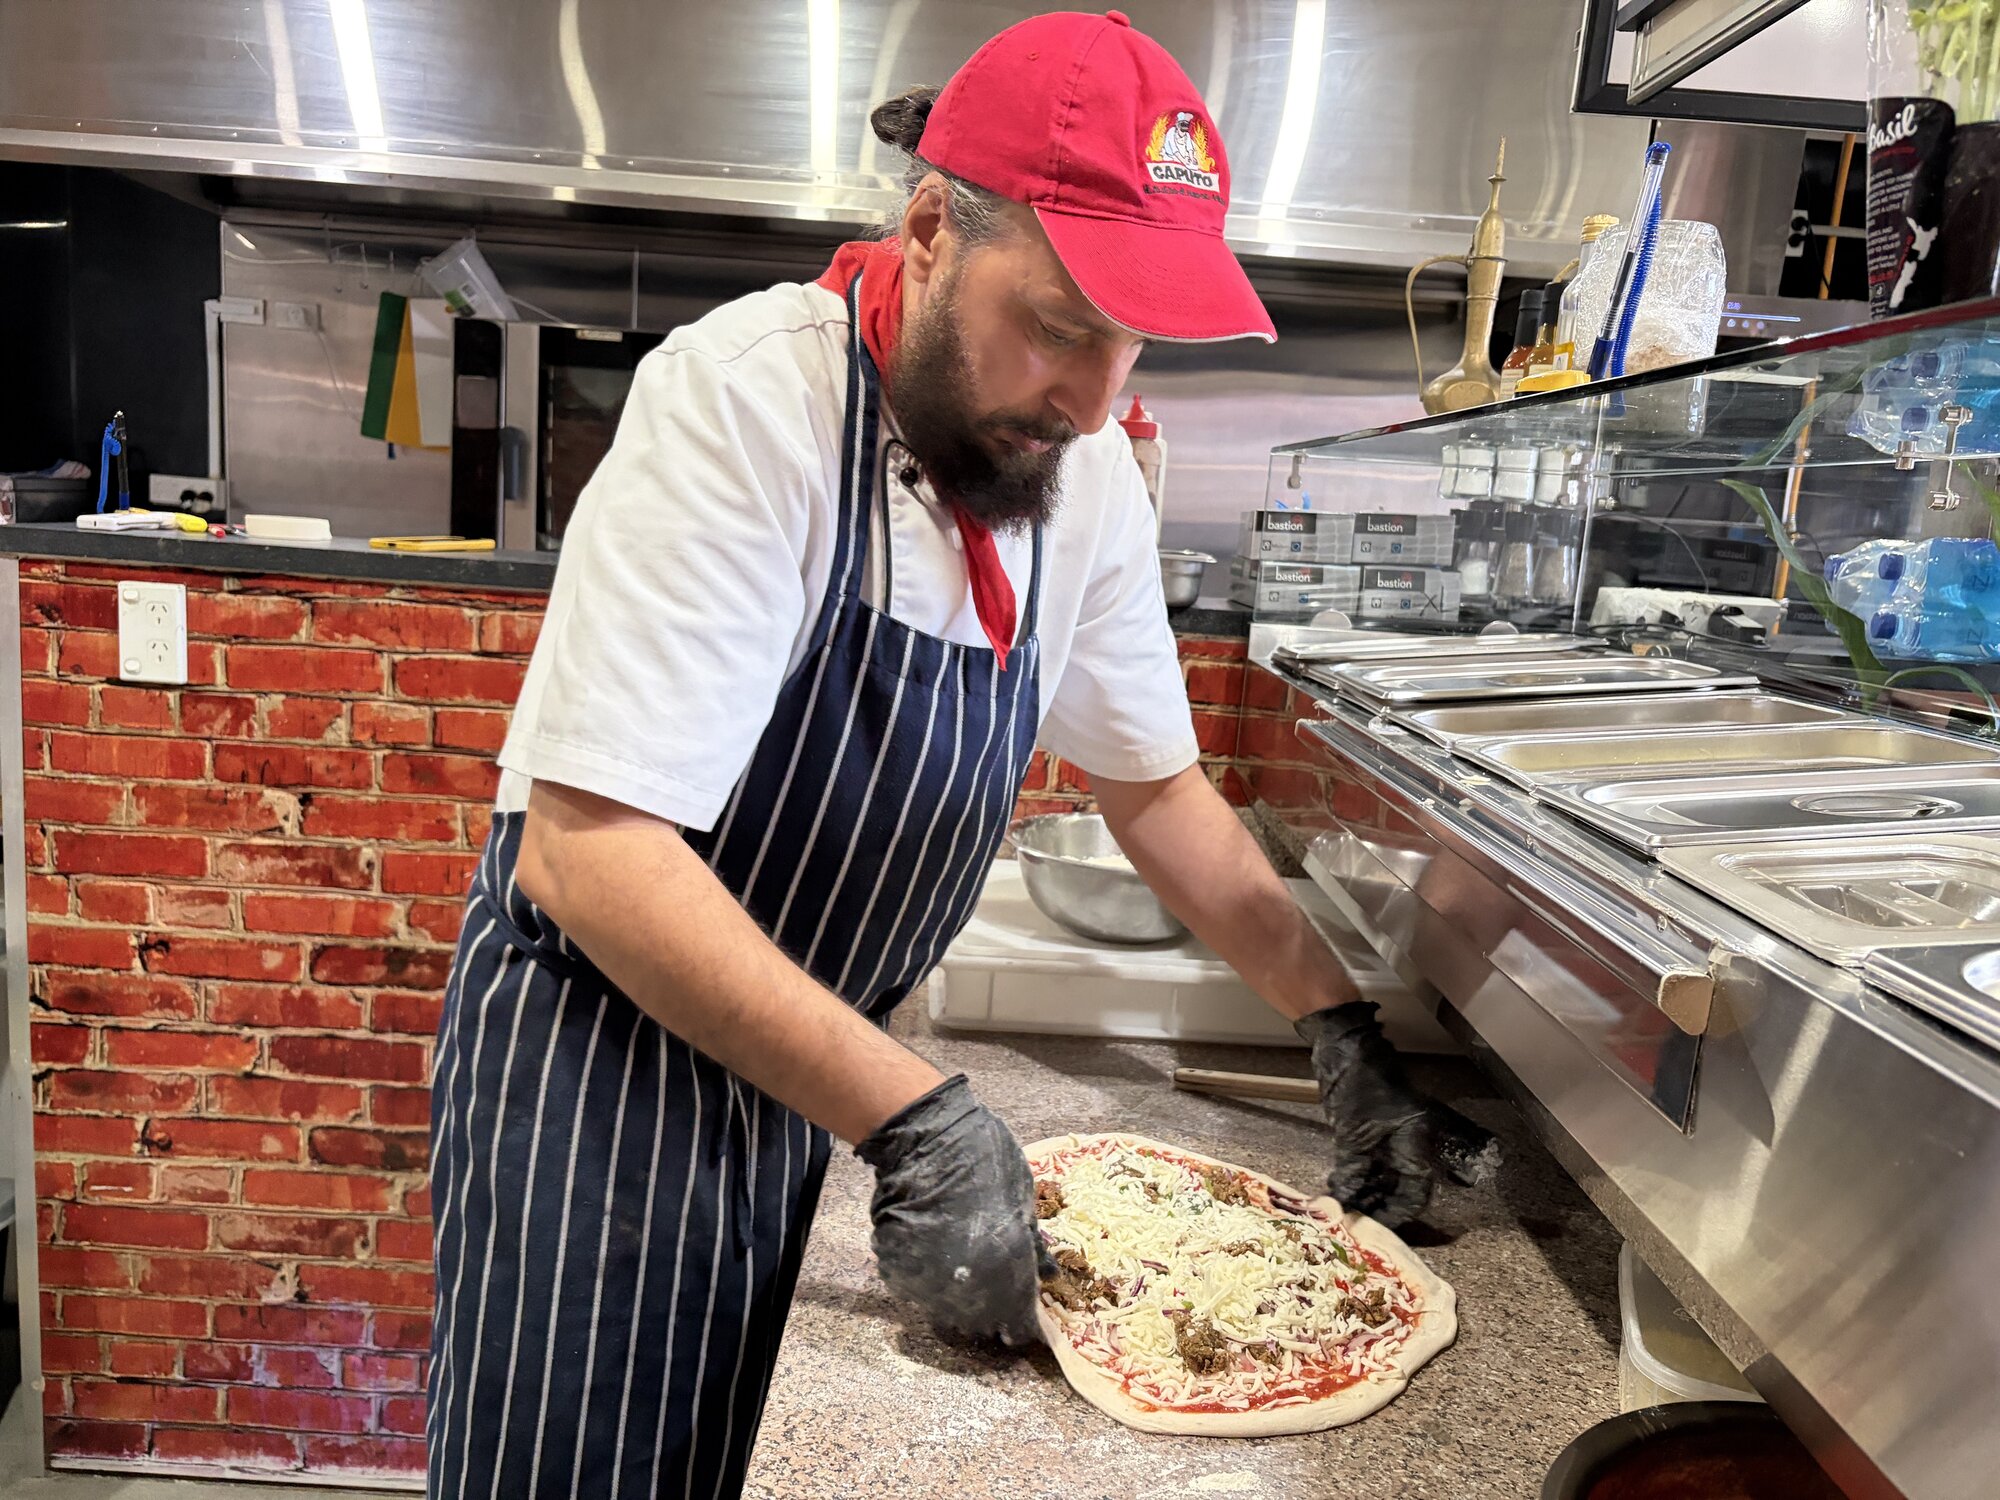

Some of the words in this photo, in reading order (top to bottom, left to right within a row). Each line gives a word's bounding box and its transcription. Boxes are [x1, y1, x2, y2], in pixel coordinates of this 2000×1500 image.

[1867, 104, 1917, 152] basil
[1152, 166, 1213, 187] CAPUTO
[1268, 513, 1303, 531] bastion
[1367, 515, 1403, 533] bastion
[1275, 565, 1311, 583] bastion
[1377, 572, 1413, 589] bastion
